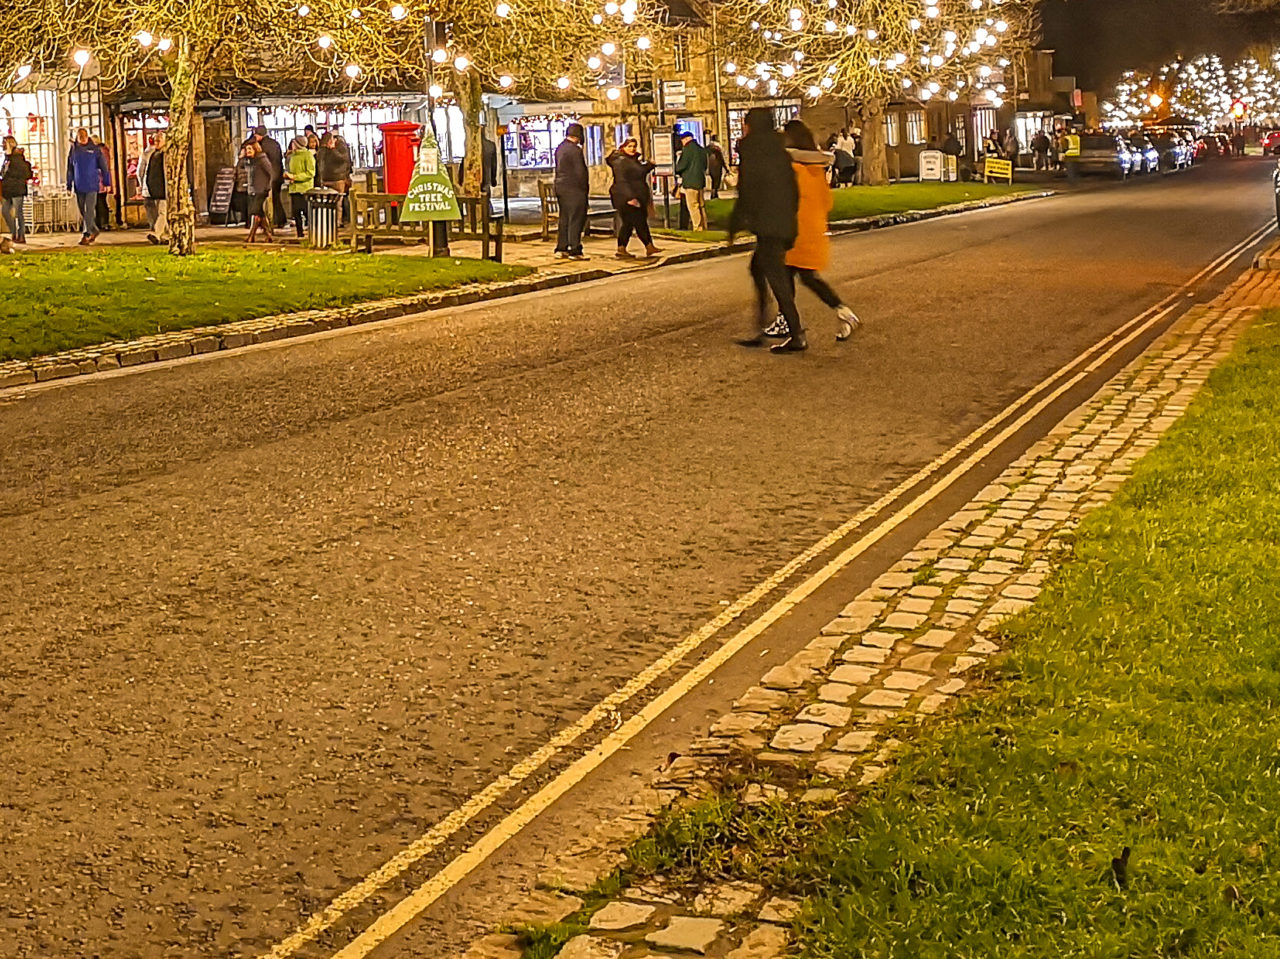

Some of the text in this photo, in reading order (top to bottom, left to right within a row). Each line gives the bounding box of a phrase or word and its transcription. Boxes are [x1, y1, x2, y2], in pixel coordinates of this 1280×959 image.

[408, 183, 454, 199] CHRISTMAS
[419, 194, 442, 202] TREE
[410, 202, 451, 212] FESTIVAL
